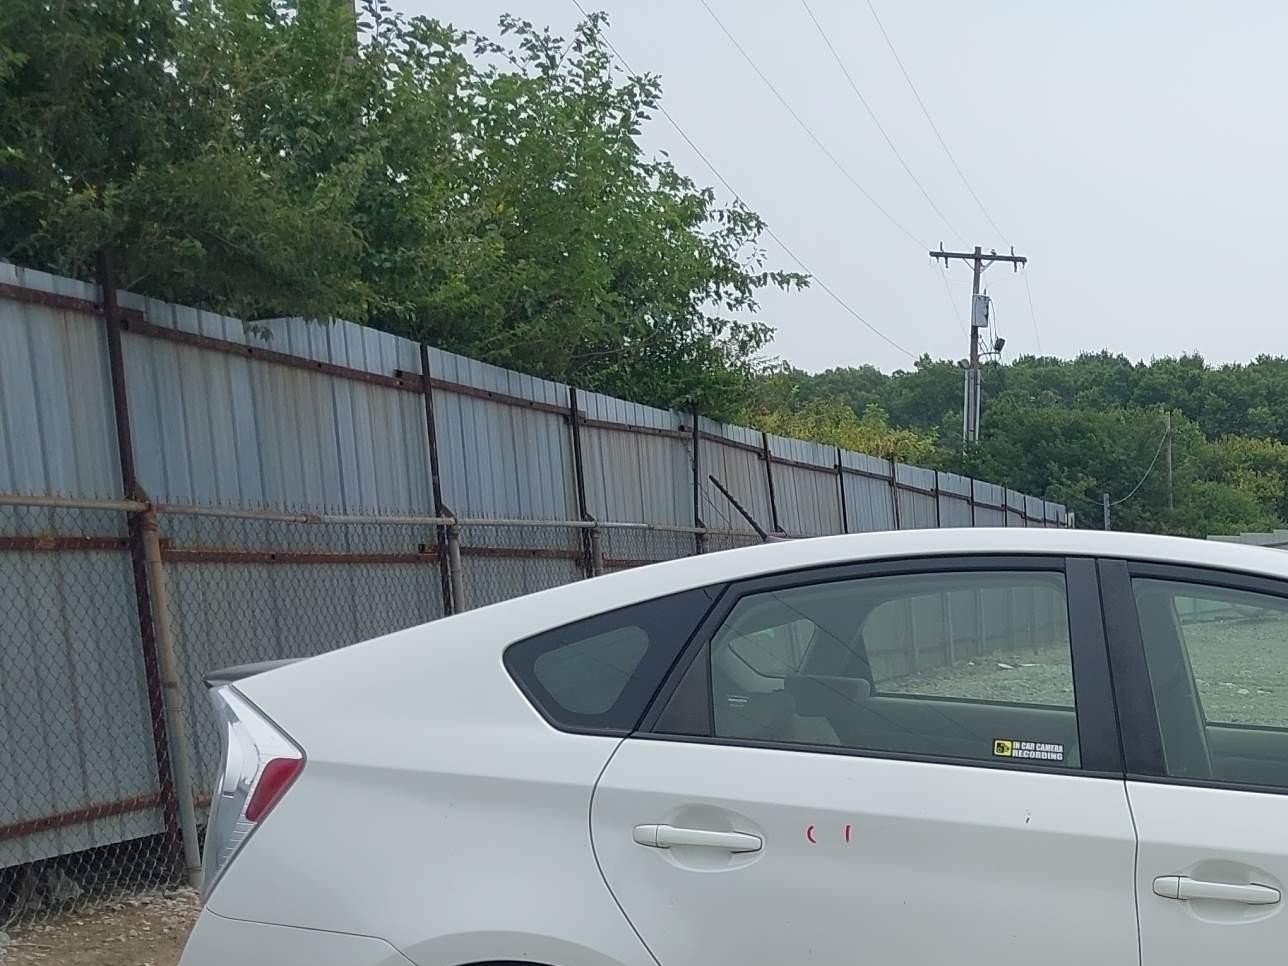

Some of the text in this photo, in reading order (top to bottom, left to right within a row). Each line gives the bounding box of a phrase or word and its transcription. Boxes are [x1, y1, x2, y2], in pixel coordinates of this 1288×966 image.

[1013, 741, 1063, 752] IN CAR CAMERA
[1012, 750, 1063, 760] RECORDING
